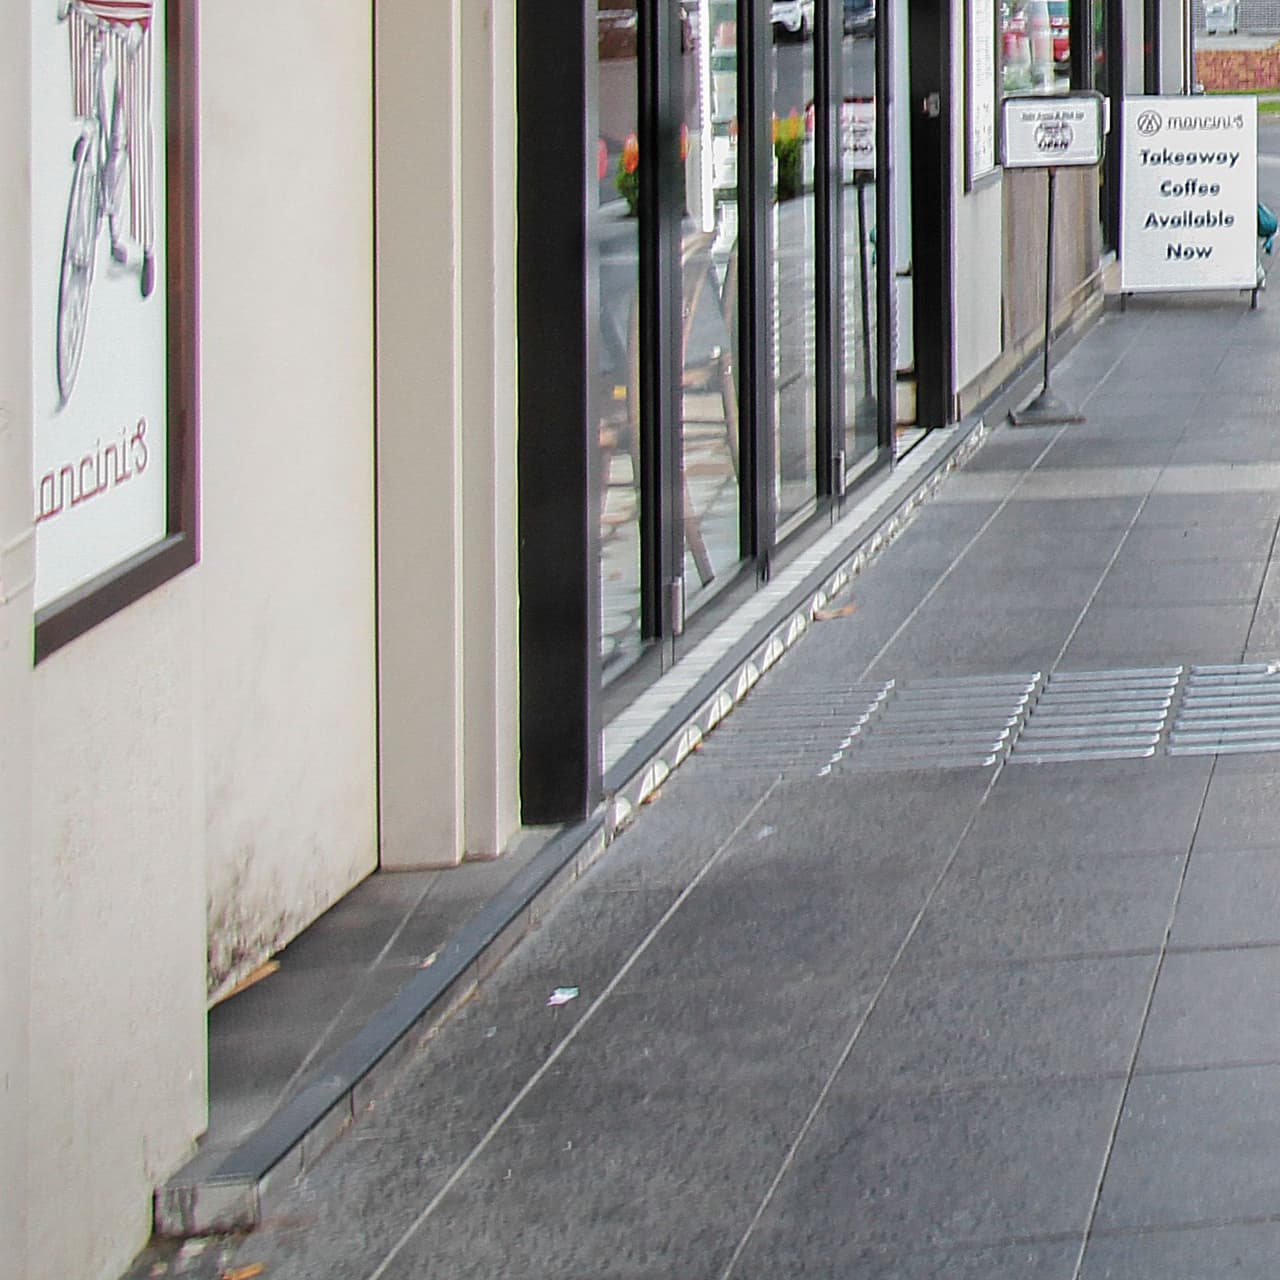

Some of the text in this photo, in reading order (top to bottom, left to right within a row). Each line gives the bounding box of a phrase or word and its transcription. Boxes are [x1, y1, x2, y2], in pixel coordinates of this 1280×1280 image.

[1140, 147, 1240, 169] Takeaway
[1160, 178, 1221, 198] Coffee
[1144, 209, 1235, 230] Available
[1166, 243, 1213, 261] Now
